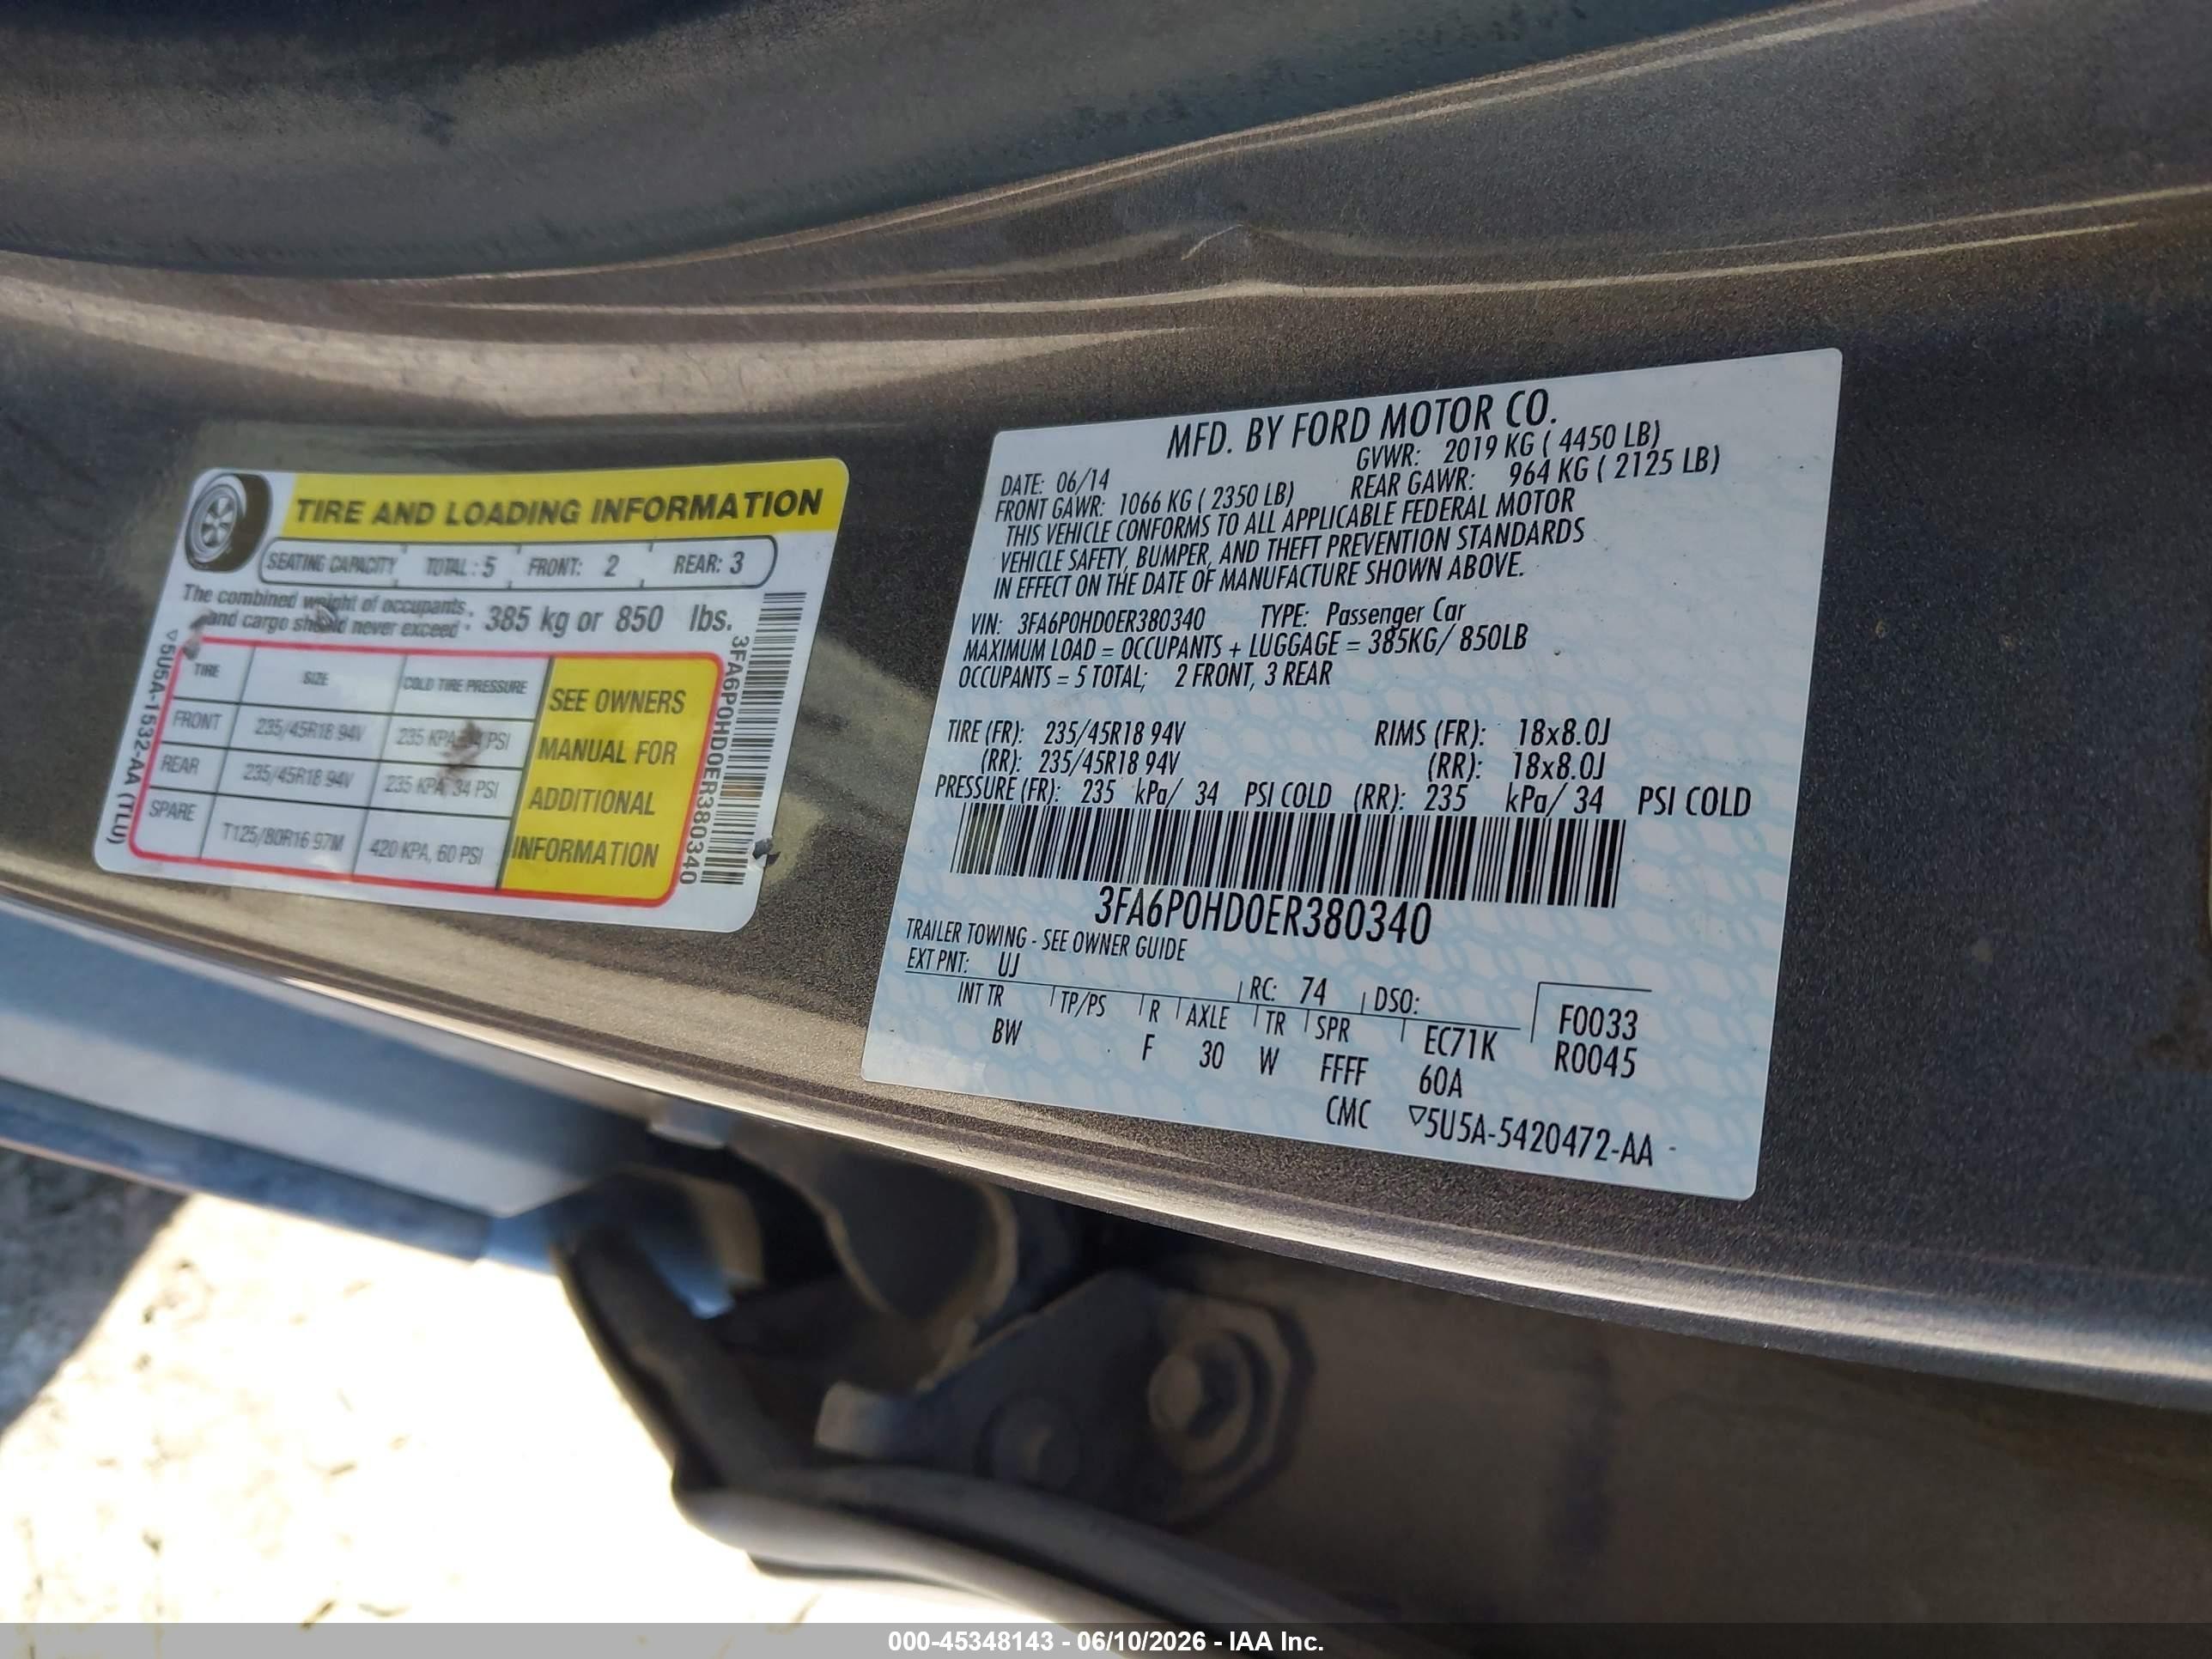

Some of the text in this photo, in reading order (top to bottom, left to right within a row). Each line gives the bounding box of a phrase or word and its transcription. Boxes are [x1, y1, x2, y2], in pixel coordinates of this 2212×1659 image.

[1166, 388, 1557, 459] MFD. BY FORD MOTOR CO.
[1356, 419, 1661, 472] GVWR: 2019 KG 4450 LB)
[1000, 467, 1110, 497] DATE: 06/14
[1350, 444, 1720, 500] REAR GAWR: 964 KG 2125 LB)
[297, 489, 823, 526] TIRE AND LOADING INFORMATION
[994, 480, 1295, 523] FRONT GAWR: 1066 KG 2350 LB)
[1006, 487, 1576, 547] THIS VEHICLE CONFORMS ALL APPLICABLE FEDERAL MOTOR
[1000, 517, 1585, 574] VEHICLE SAFETY, BUMPER, AND THEFT PREVENTION STANDARDS
[482, 556, 498, 577] 5
[527, 555, 620, 577] FRONT: 2
[673, 551, 744, 574] REAR: 3
[1016, 550, 1524, 599] EFFECT THE DATE OF MANUFACTURE SHOWN ABOVE.
[184, 584, 295, 609] The combined
[485, 605, 732, 637] 385 kg or 850 lbs.
[971, 607, 1206, 635] VIN: 3FA6P0HD0ER380340
[1261, 596, 1467, 629] TYPE: Passenger Car
[963, 623, 1528, 662] MAXIMUM LOAD OCCUPANTS LUGGAGE 385KG/ 850LB
[194, 663, 220, 678] TIRE
[303, 671, 329, 686] SIZE
[959, 660, 1333, 692] OCCUPANTS TOTAL; FRONT, REAR
[465, 679, 528, 695] PRESSURE
[550, 688, 687, 714] SEE OWNERS
[173, 710, 222, 731] FRONT
[947, 719, 1186, 747] TIRE (FR): 235/45R18 94V
[1374, 717, 1611, 749] RIMS (FR): 18x8.0J
[161, 755, 199, 775] REAR
[537, 737, 678, 765] MANUAL FOR
[981, 748, 1181, 777] (RR): 235/45R18 94V
[1428, 751, 1607, 782] (RR): 18x8.0J
[529, 786, 656, 816] ADDITIONAL
[935, 774, 1333, 811] PRESSURE (FR): 235 kPa/ 34 PSI COLD
[1353, 781, 1752, 817] (RR): 235 kPa/ 34 PSI COLD
[107, 793, 137, 844] (TLU)
[149, 799, 197, 821] SPARE
[223, 823, 311, 848] T125/80R16
[369, 838, 398, 858] 420
[438, 844, 456, 863] 60
[459, 847, 483, 866] PSI
[513, 836, 659, 868] INFORMATION
[1095, 885, 1431, 945] 3FA6P0HD0ER380340
[906, 918, 1188, 962] TRAILER TOWING SEE OWNER GUIDE
[908, 947, 1020, 978] EXT PNT: UJ
[957, 981, 984, 1005] INT
[1060, 990, 1107, 1018] TP/PS
[1249, 975, 1328, 1006] RC: 74
[1374, 987, 1419, 1014] DSO:
[992, 1018, 1023, 1046] BW
[1185, 1003, 1230, 1030] AXLE
[1315, 1015, 1351, 1042] SPR
[1559, 1004, 1638, 1041] F0033
[1199, 1040, 1224, 1069] 30
[1425, 1024, 1498, 1061] EC71K
[1320, 1054, 1369, 1085] FFFF
[1554, 1041, 1637, 1079] R0045
[1419, 1064, 1463, 1098] 60A
[1326, 1095, 1371, 1129] CMC
[1425, 1108, 1653, 1166] 5U5A-5420472-AA
